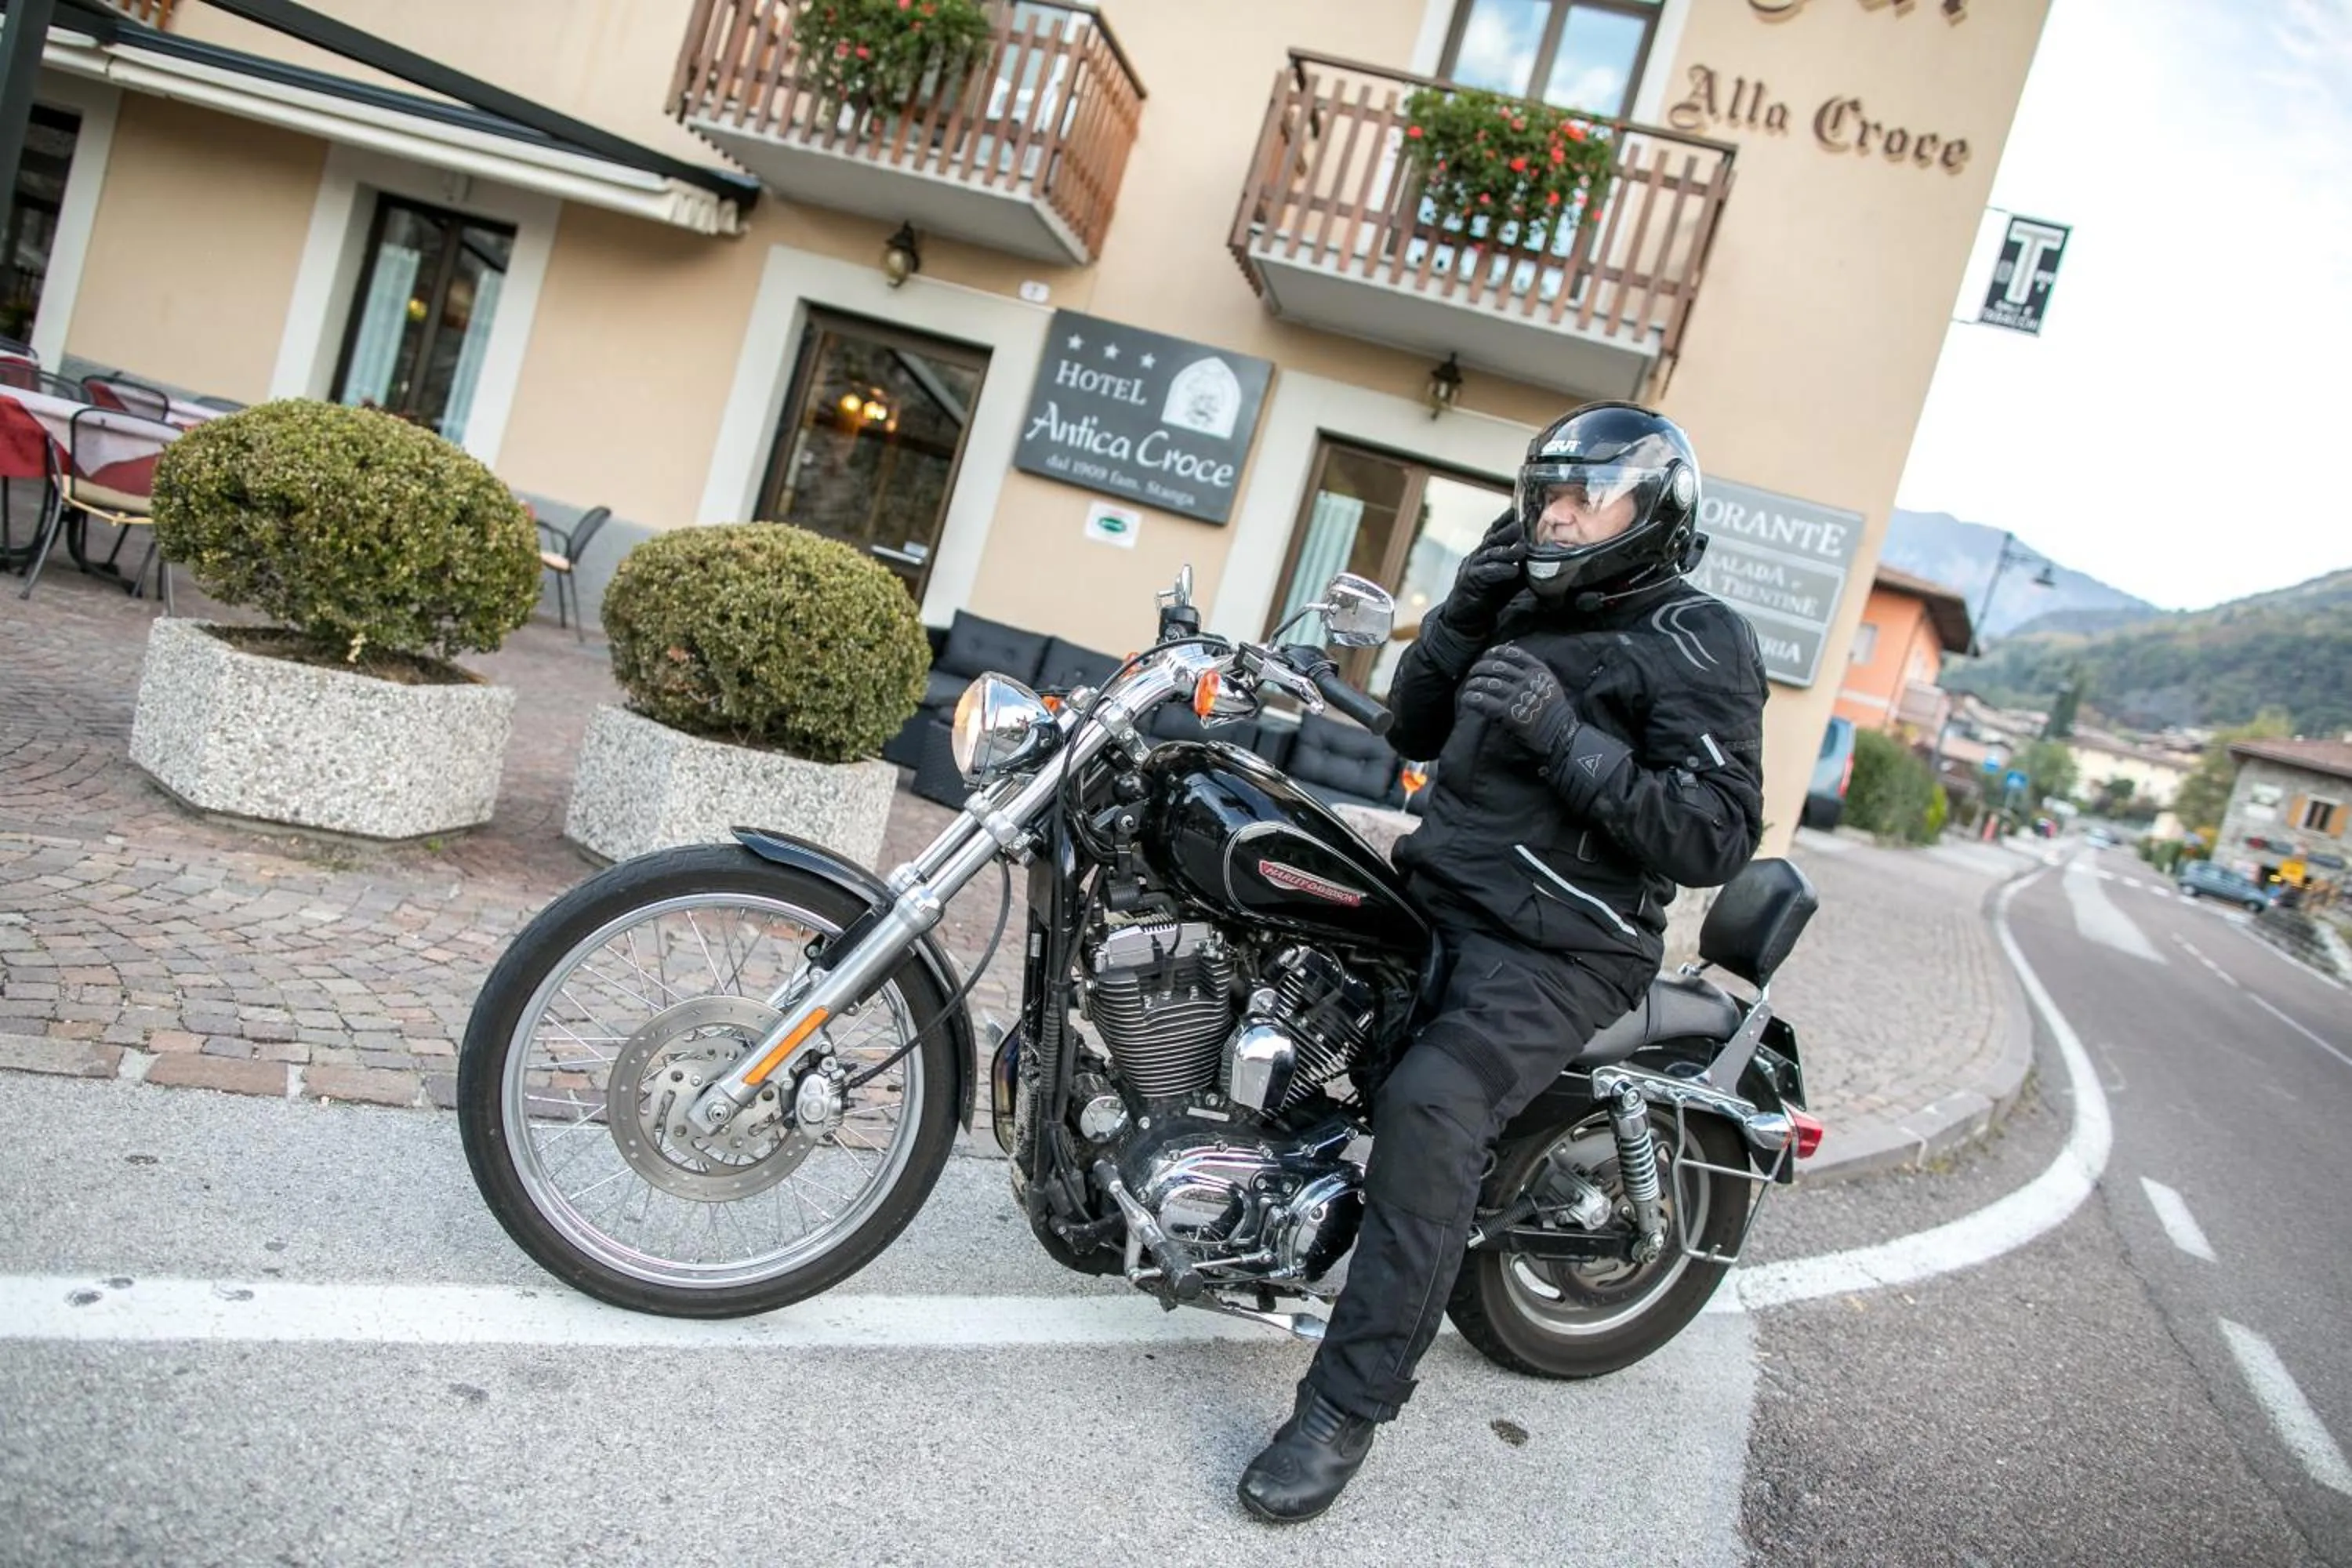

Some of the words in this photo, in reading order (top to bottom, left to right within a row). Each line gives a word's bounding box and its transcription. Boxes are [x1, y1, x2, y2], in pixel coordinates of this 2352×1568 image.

[1669, 64, 1790, 136] Alla
[1813, 95, 1970, 175] Croce
[1054, 359, 1147, 406] HOTEL
[1025, 401, 1131, 461] Antica
[1136, 430, 1234, 488] Croce
[1700, 497, 1846, 557] ORANTE
